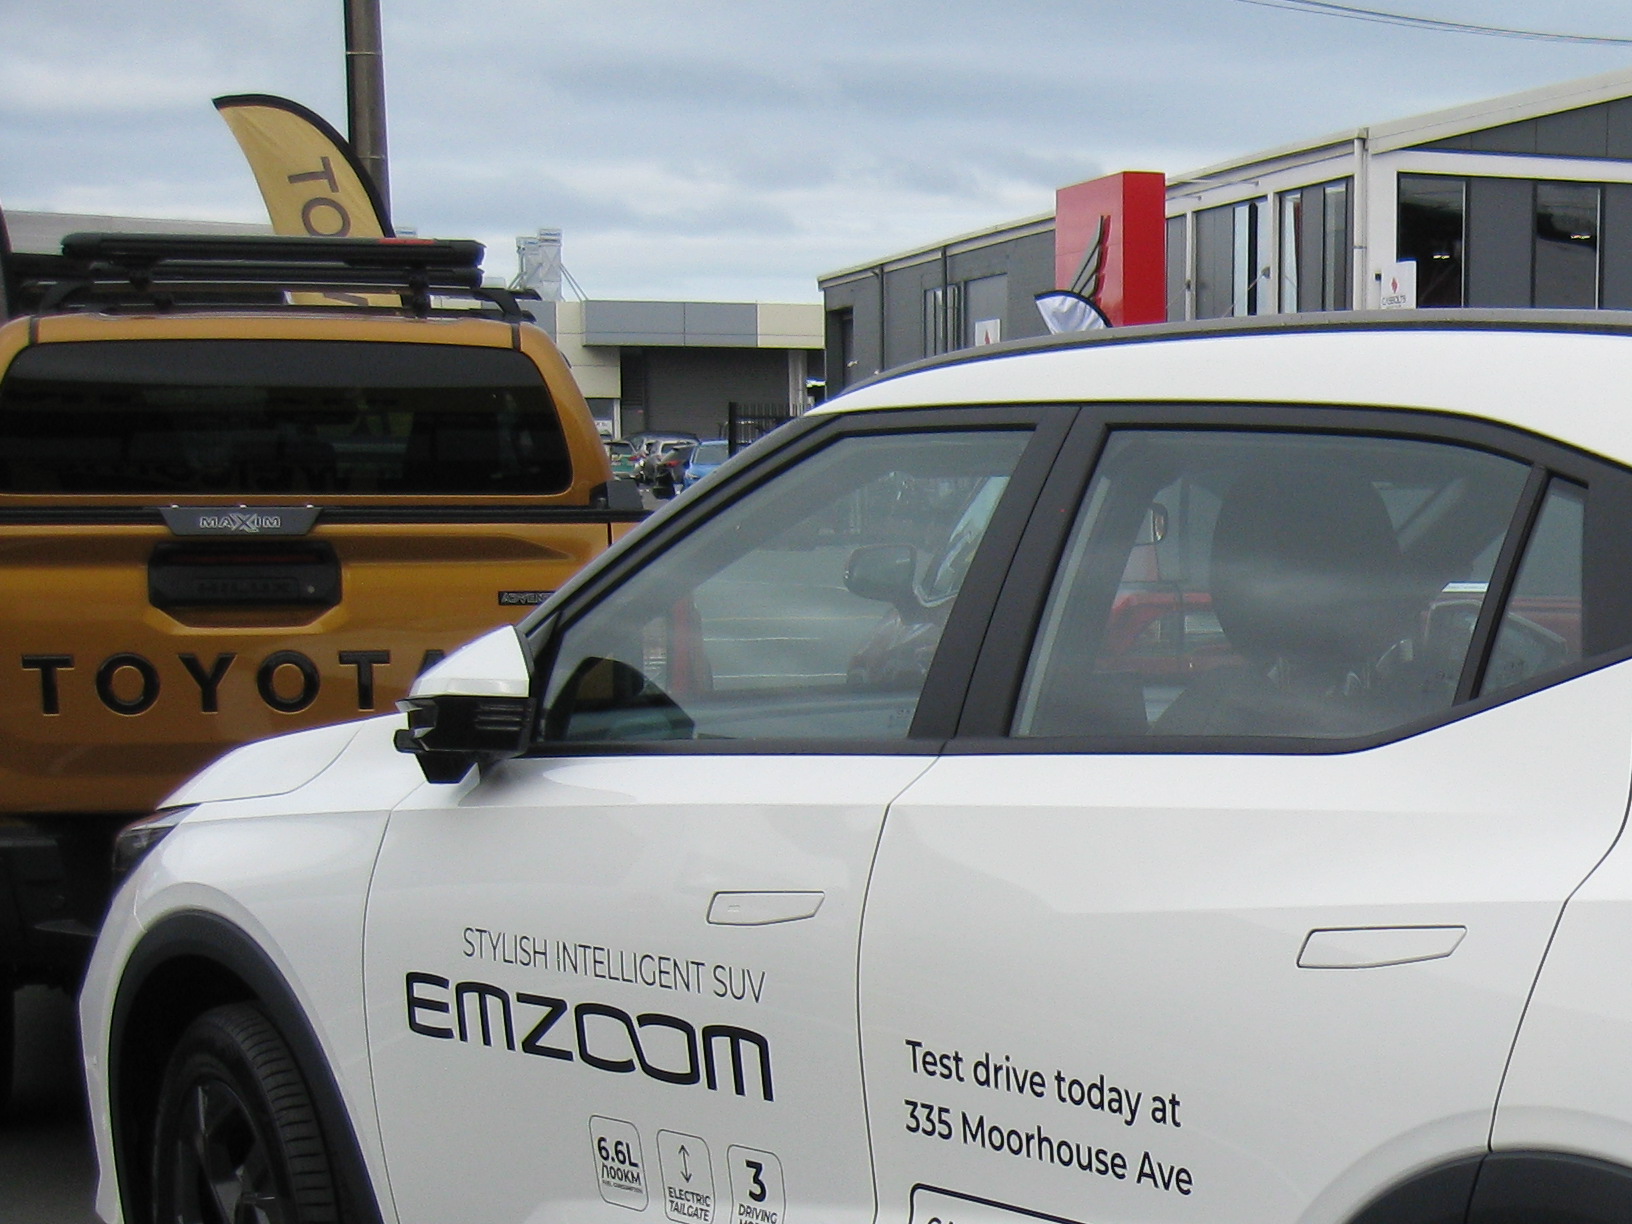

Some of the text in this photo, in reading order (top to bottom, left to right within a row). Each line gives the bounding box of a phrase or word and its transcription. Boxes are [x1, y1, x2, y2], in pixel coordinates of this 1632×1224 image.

[199, 512, 282, 533] MAXIM
[501, 592, 553, 605] ADVEN
[462, 927, 765, 1003] STYLISH INTELLIGENT SUV
[405, 971, 774, 1102] EMZOOM
[904, 1038, 1182, 1128] Test drive today at
[597, 1136, 640, 1168] 6.6L
[903, 1099, 1193, 1196] 335 Moorhouse Ave
[667, 1186, 711, 1208] ELECTRIC
[745, 1159, 767, 1203] 3
[668, 1200, 710, 1222] TAILGATE
[737, 1203, 777, 1224] DRIVING
